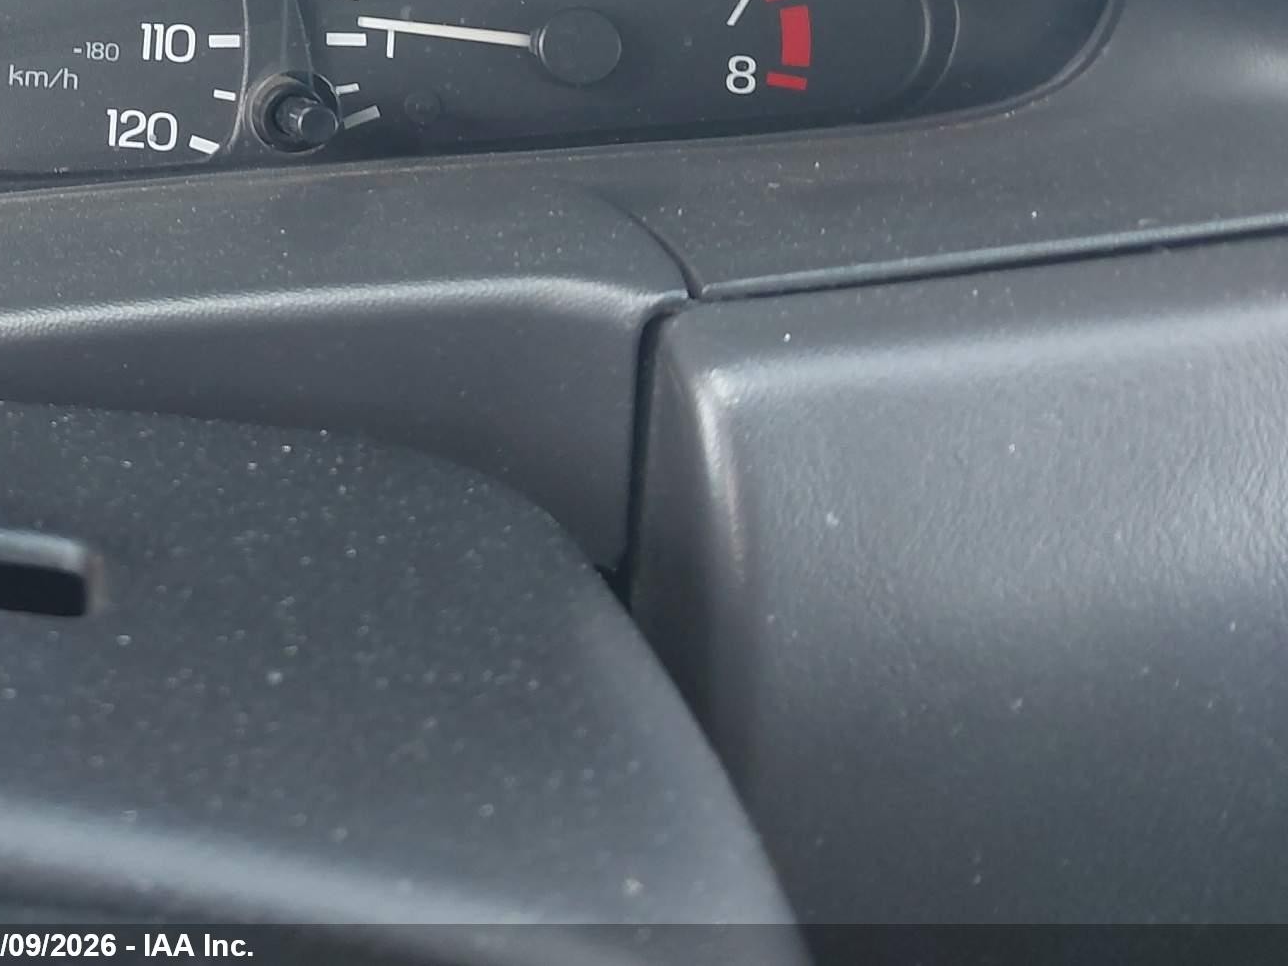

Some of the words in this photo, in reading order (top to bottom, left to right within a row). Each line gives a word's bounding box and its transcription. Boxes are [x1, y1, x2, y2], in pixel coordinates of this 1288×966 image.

[86, 42, 119, 61] 180
[142, 23, 195, 62] 110
[9, 65, 77, 89] km/h
[726, 56, 756, 93] 8
[107, 109, 177, 150] 120
